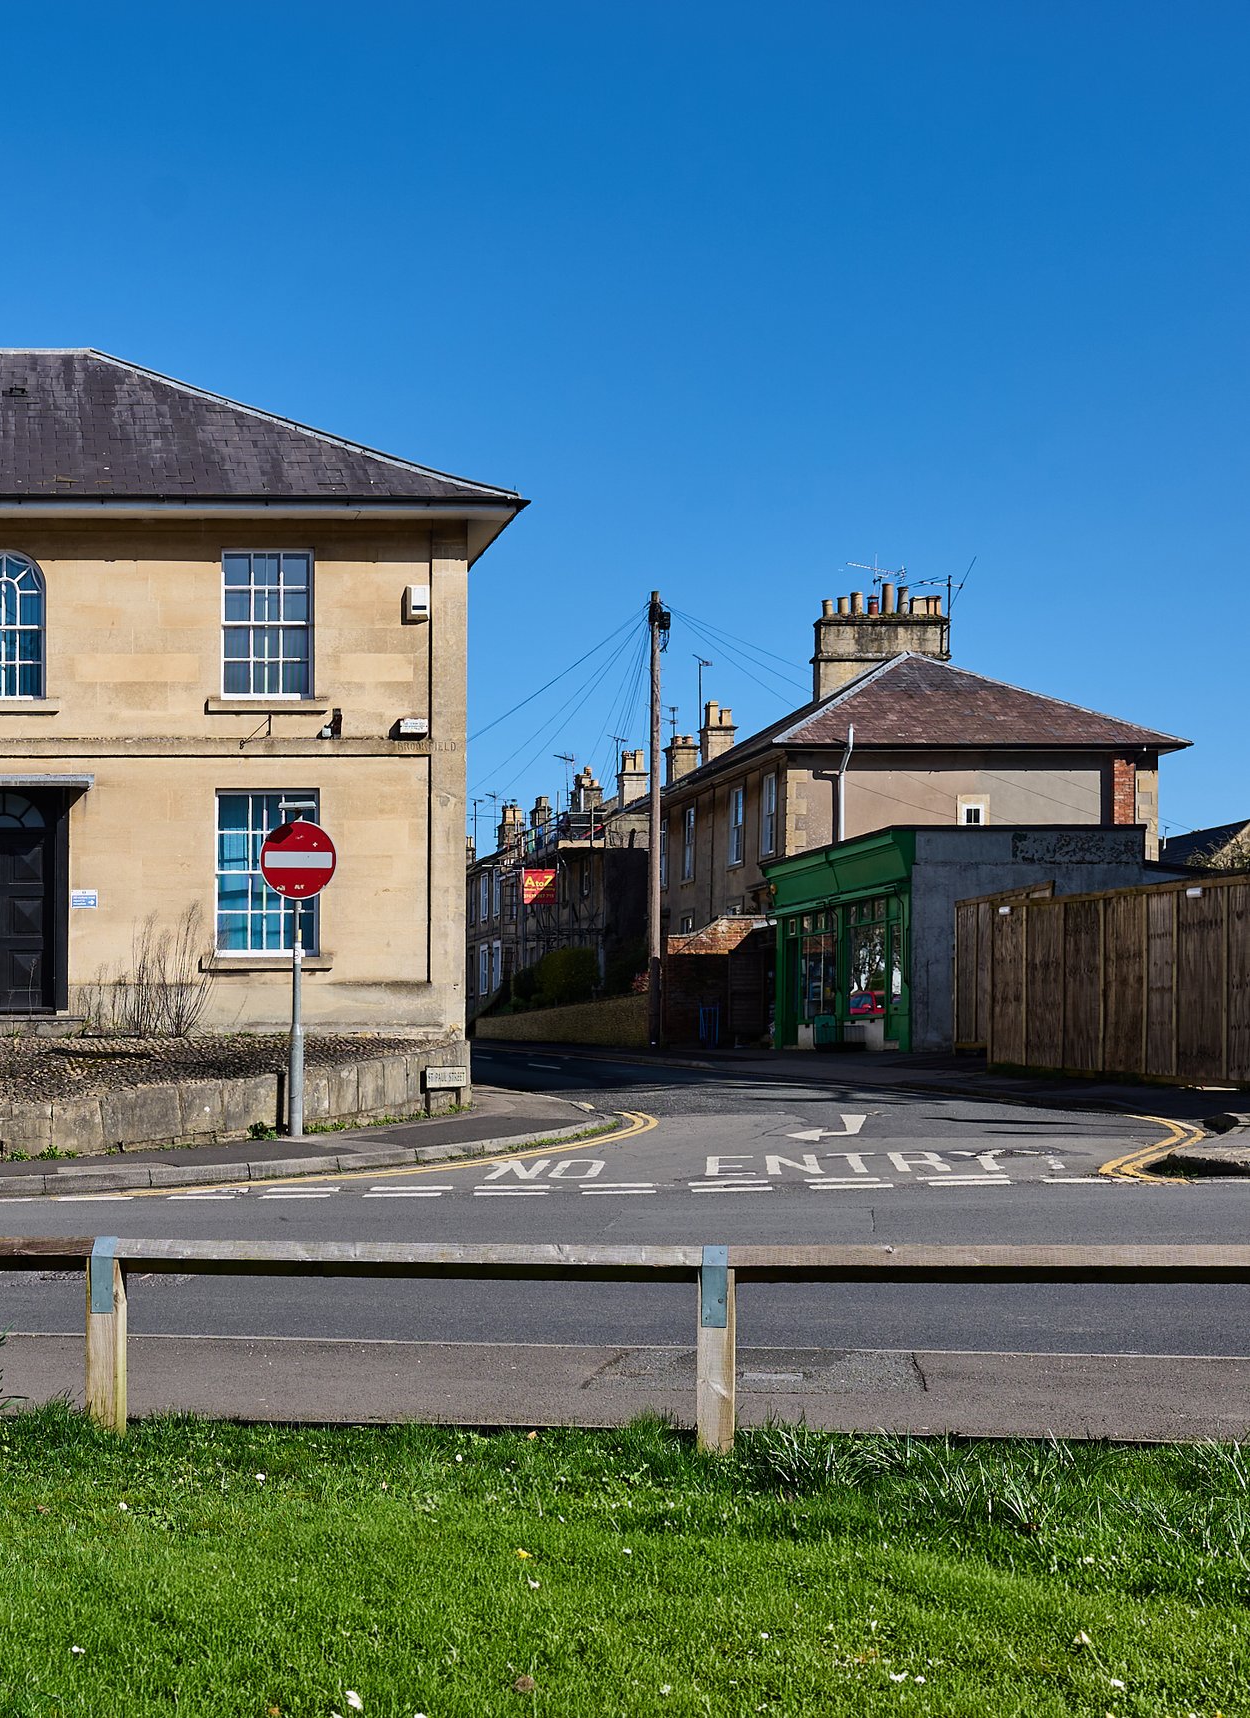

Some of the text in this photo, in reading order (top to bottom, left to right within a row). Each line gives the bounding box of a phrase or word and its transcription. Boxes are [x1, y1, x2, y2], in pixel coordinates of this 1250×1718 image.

[397, 741, 456, 752] BROOKFIELD
[524, 875, 535, 887] A
[543, 875, 553, 886] Z
[485, 1149, 1006, 1180] NO ENTRY
